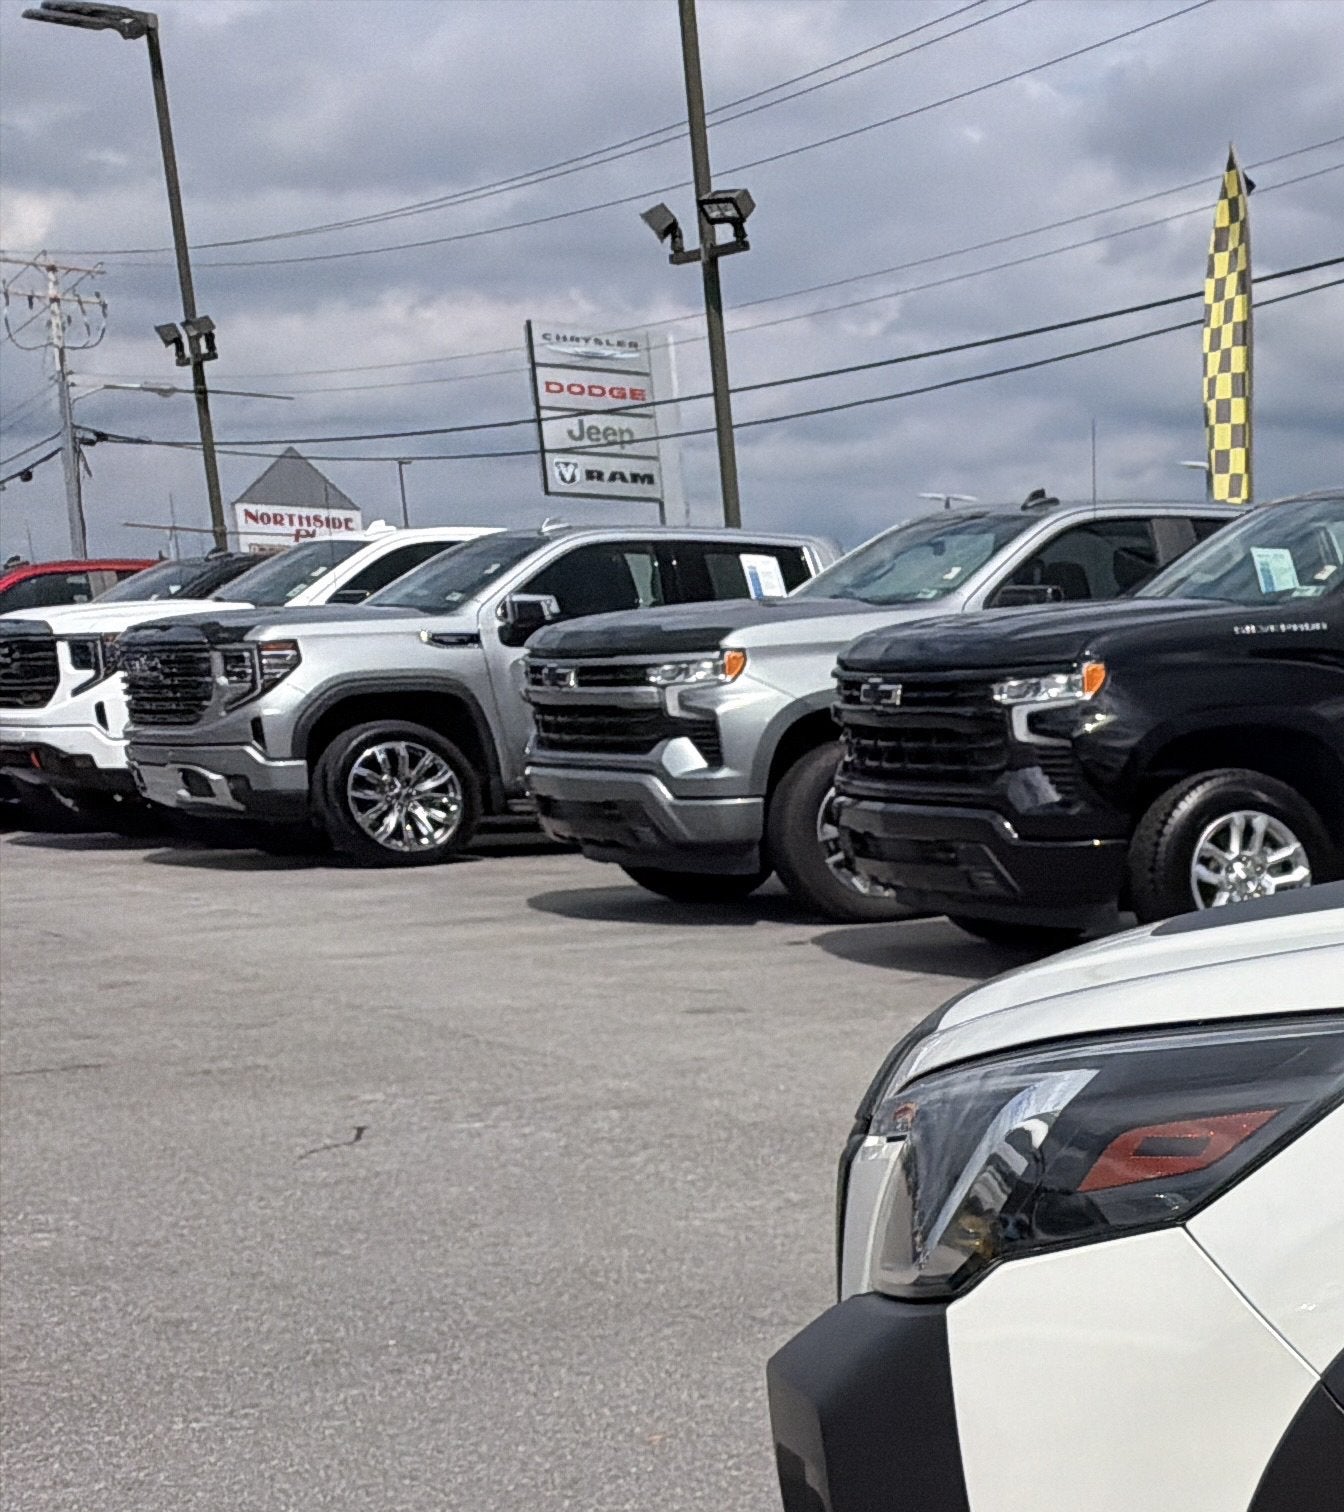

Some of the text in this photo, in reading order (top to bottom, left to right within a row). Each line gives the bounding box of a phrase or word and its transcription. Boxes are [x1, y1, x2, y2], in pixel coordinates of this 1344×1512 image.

[541, 332, 640, 349] CHRYSLER
[544, 380, 647, 401] DODGE
[566, 418, 635, 450] Jeep
[585, 468, 655, 486] RAM
